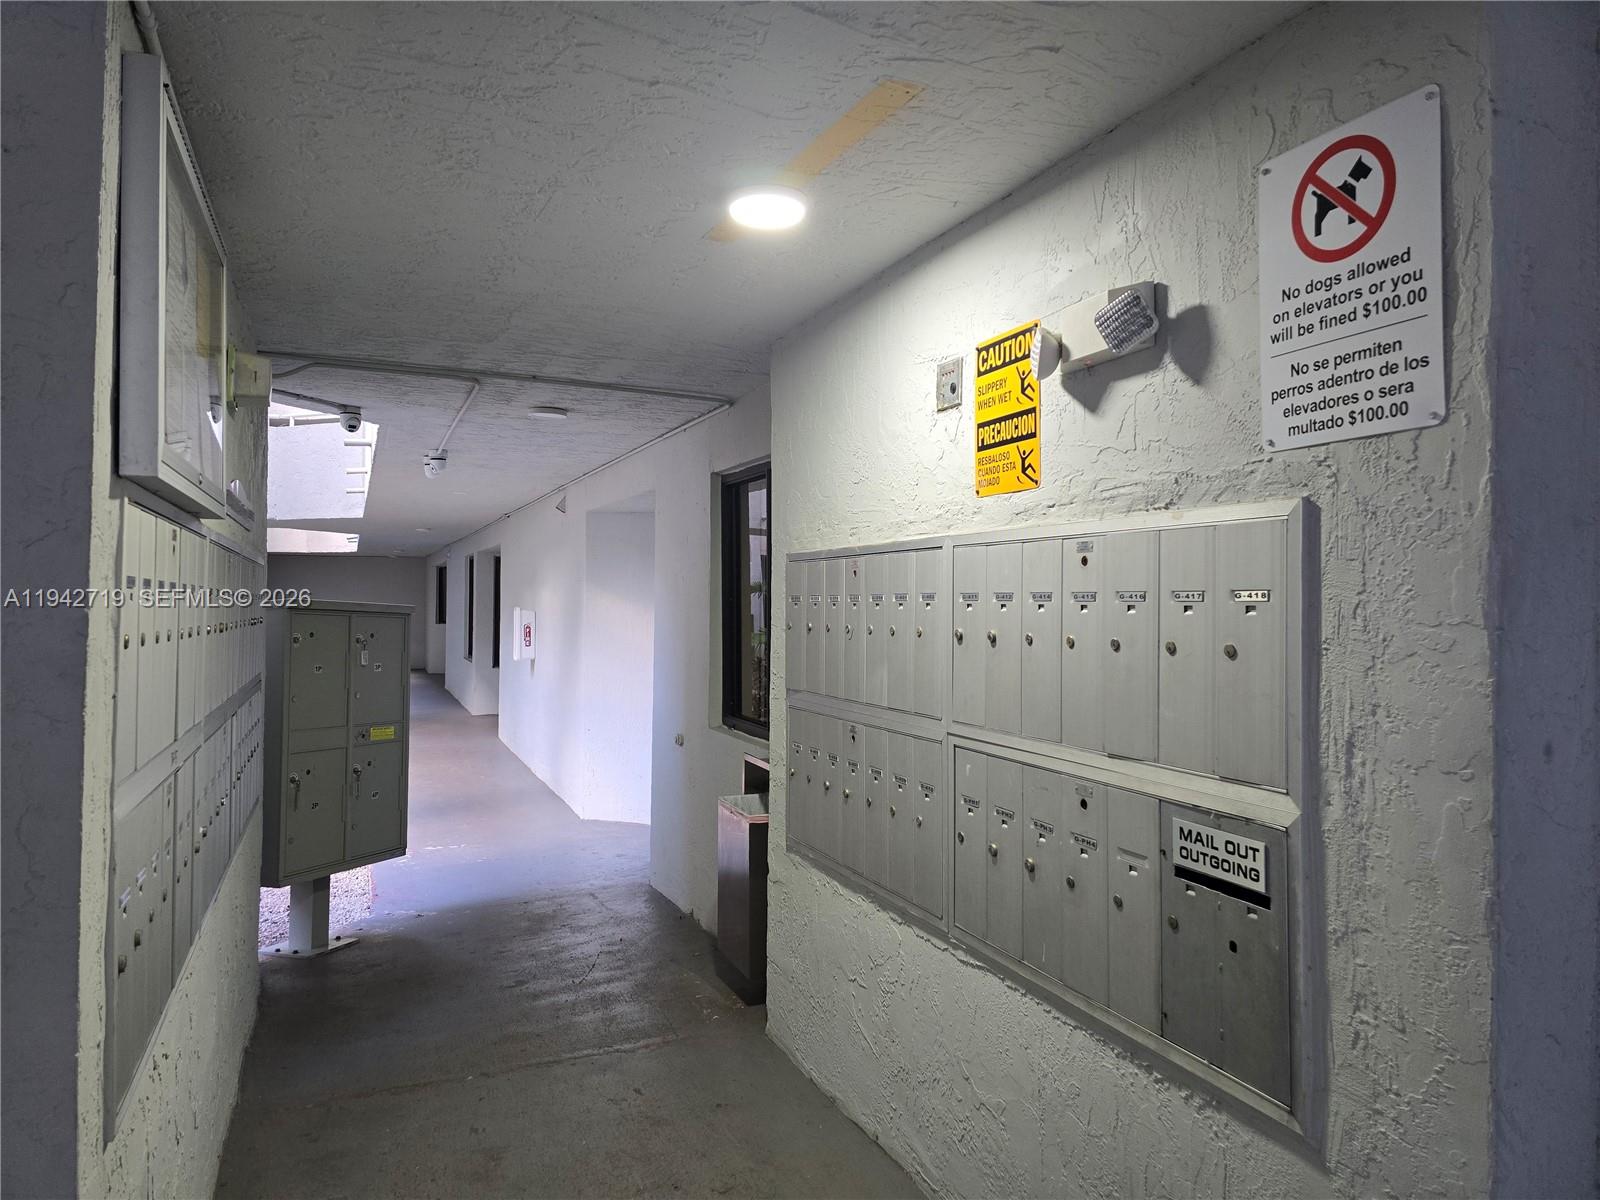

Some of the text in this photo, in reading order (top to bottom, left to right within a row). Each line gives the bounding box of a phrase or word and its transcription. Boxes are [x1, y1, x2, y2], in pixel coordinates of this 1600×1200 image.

[1281, 246, 1411, 302] No dogs allowed
[1273, 269, 1424, 324] on elevators or you
[1270, 286, 1427, 344] will be fined $100.00
[979, 330, 1034, 372] CAUTION
[1290, 340, 1402, 377] No se permiten
[978, 377, 1007, 397] SLIPPERY
[1271, 355, 1430, 404] perros adentro de los
[978, 390, 1012, 411] WHEN WET
[1283, 381, 1414, 418] elevadores o sera
[978, 413, 1035, 447] PRECAUCION
[1288, 401, 1409, 436] multado $100.00
[978, 451, 1011, 466] RESBALOSO
[978, 461, 1017, 477] CUANDO ESTA
[1234, 592, 1267, 600] G-418
[1179, 826, 1260, 862] MAIL OUT
[1179, 845, 1260, 883] OUTGOING
